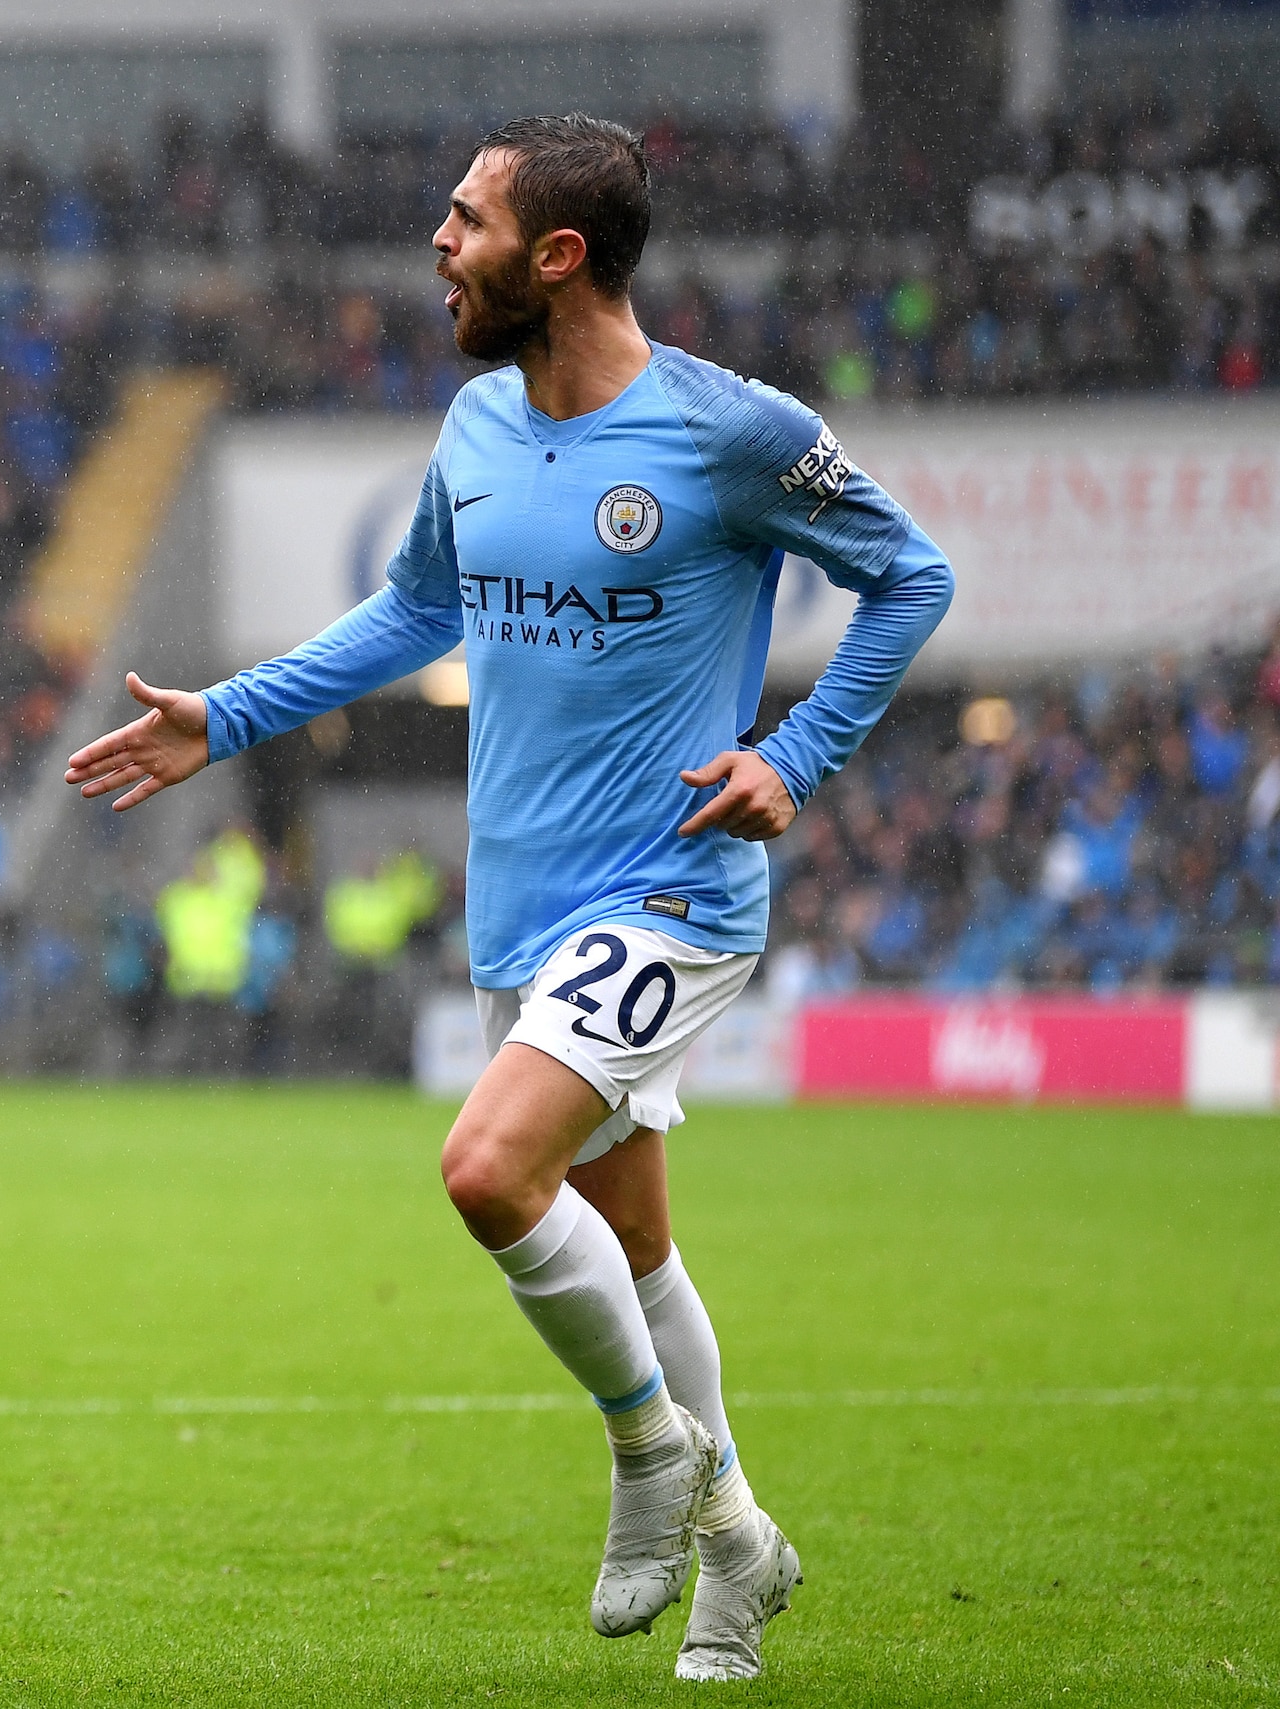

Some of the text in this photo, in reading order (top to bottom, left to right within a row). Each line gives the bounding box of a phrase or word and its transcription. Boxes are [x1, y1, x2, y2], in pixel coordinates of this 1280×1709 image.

[603, 489, 655, 512] MANCHESTER
[614, 541, 635, 549] CITY
[460, 571, 664, 623] ETIHAD
[477, 619, 606, 651] AIRWAYS
[547, 932, 676, 1048] 20
